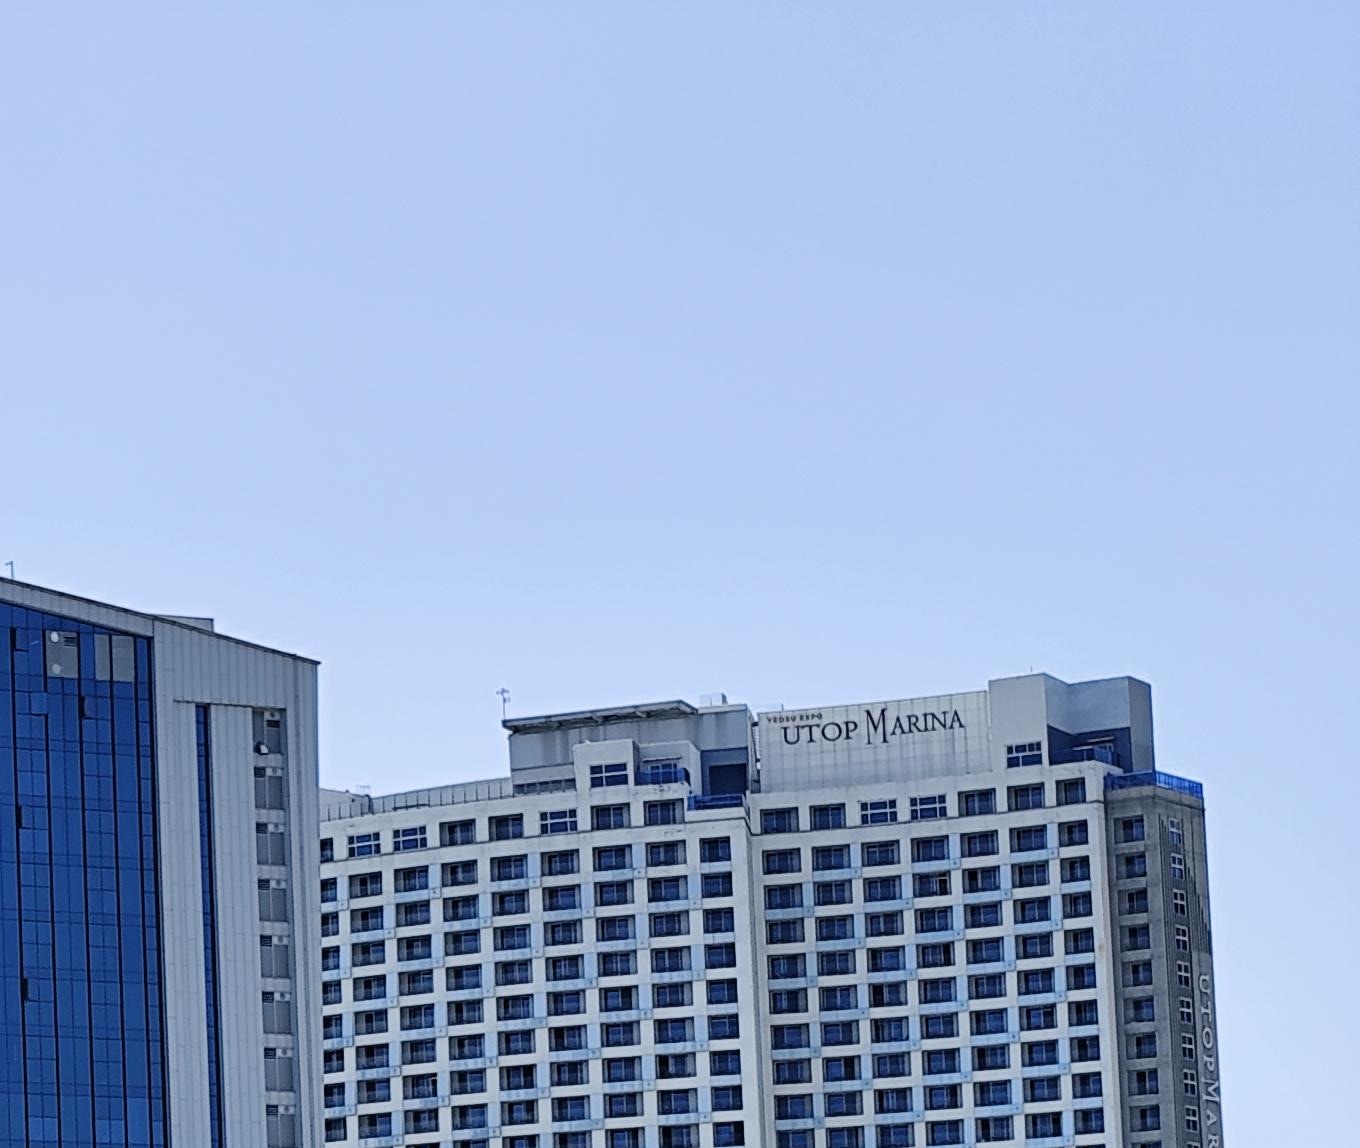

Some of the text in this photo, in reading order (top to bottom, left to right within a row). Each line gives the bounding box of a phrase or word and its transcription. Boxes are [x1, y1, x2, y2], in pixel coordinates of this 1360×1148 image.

[781, 708, 966, 746] UTOP MARINA
[1199, 974, 1215, 1072] UTOP
